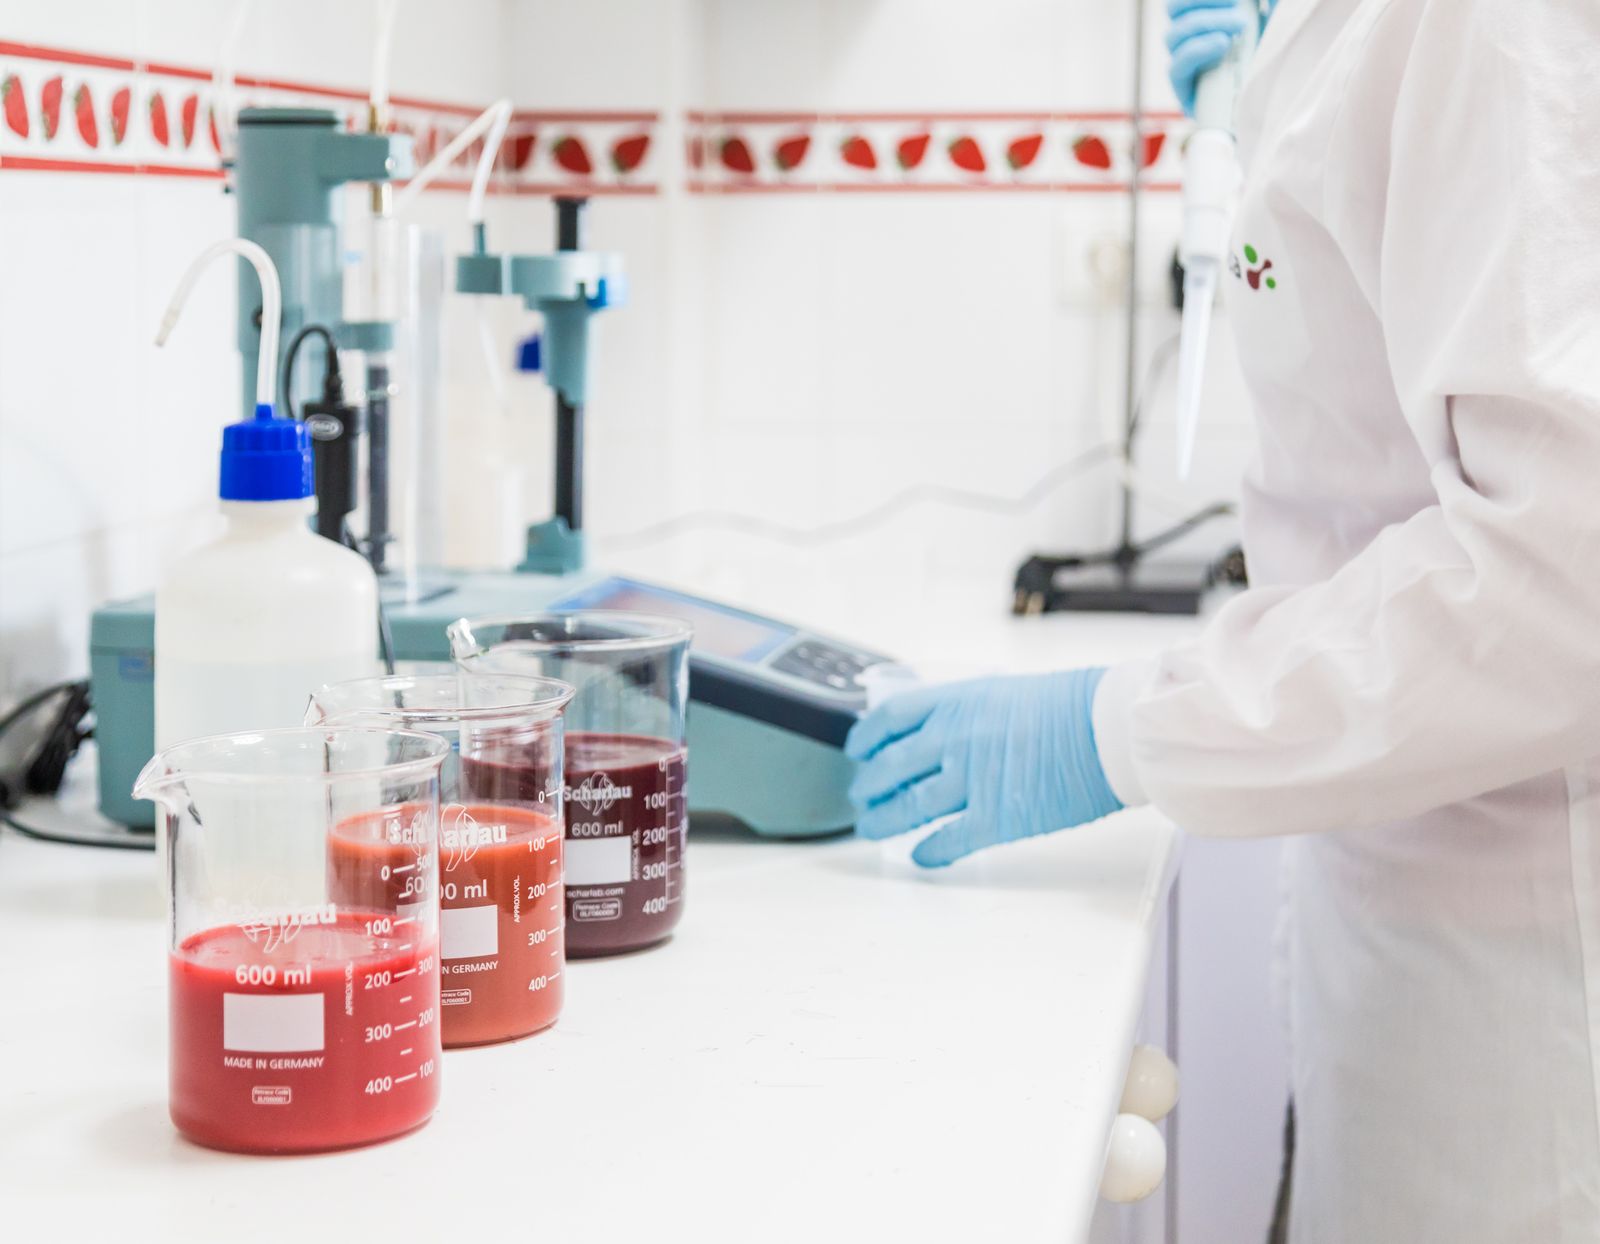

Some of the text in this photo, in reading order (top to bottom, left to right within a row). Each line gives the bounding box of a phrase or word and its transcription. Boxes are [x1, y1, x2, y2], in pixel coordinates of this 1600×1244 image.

[658, 757, 666, 772] 0
[538, 790, 545, 804] 0
[563, 785, 632, 802] Scharlau
[643, 791, 666, 810] 100
[571, 820, 624, 836] 600 ml
[642, 826, 665, 846] 200
[527, 837, 546, 853] 100
[381, 865, 390, 881] 0
[642, 861, 665, 880] 300
[464, 879, 487, 899] ml
[527, 882, 546, 900] 200
[643, 896, 666, 915] 400
[365, 918, 391, 936] 100
[527, 929, 547, 946] 300
[235, 963, 312, 985] 600 ml
[364, 955, 433, 990] 200 300
[451, 960, 499, 975] GERMANY
[528, 975, 547, 991] 400
[364, 1007, 433, 1043] 300 200
[223, 1056, 324, 1070] MADE IN GERMANY
[364, 1059, 434, 1095] 400 100
